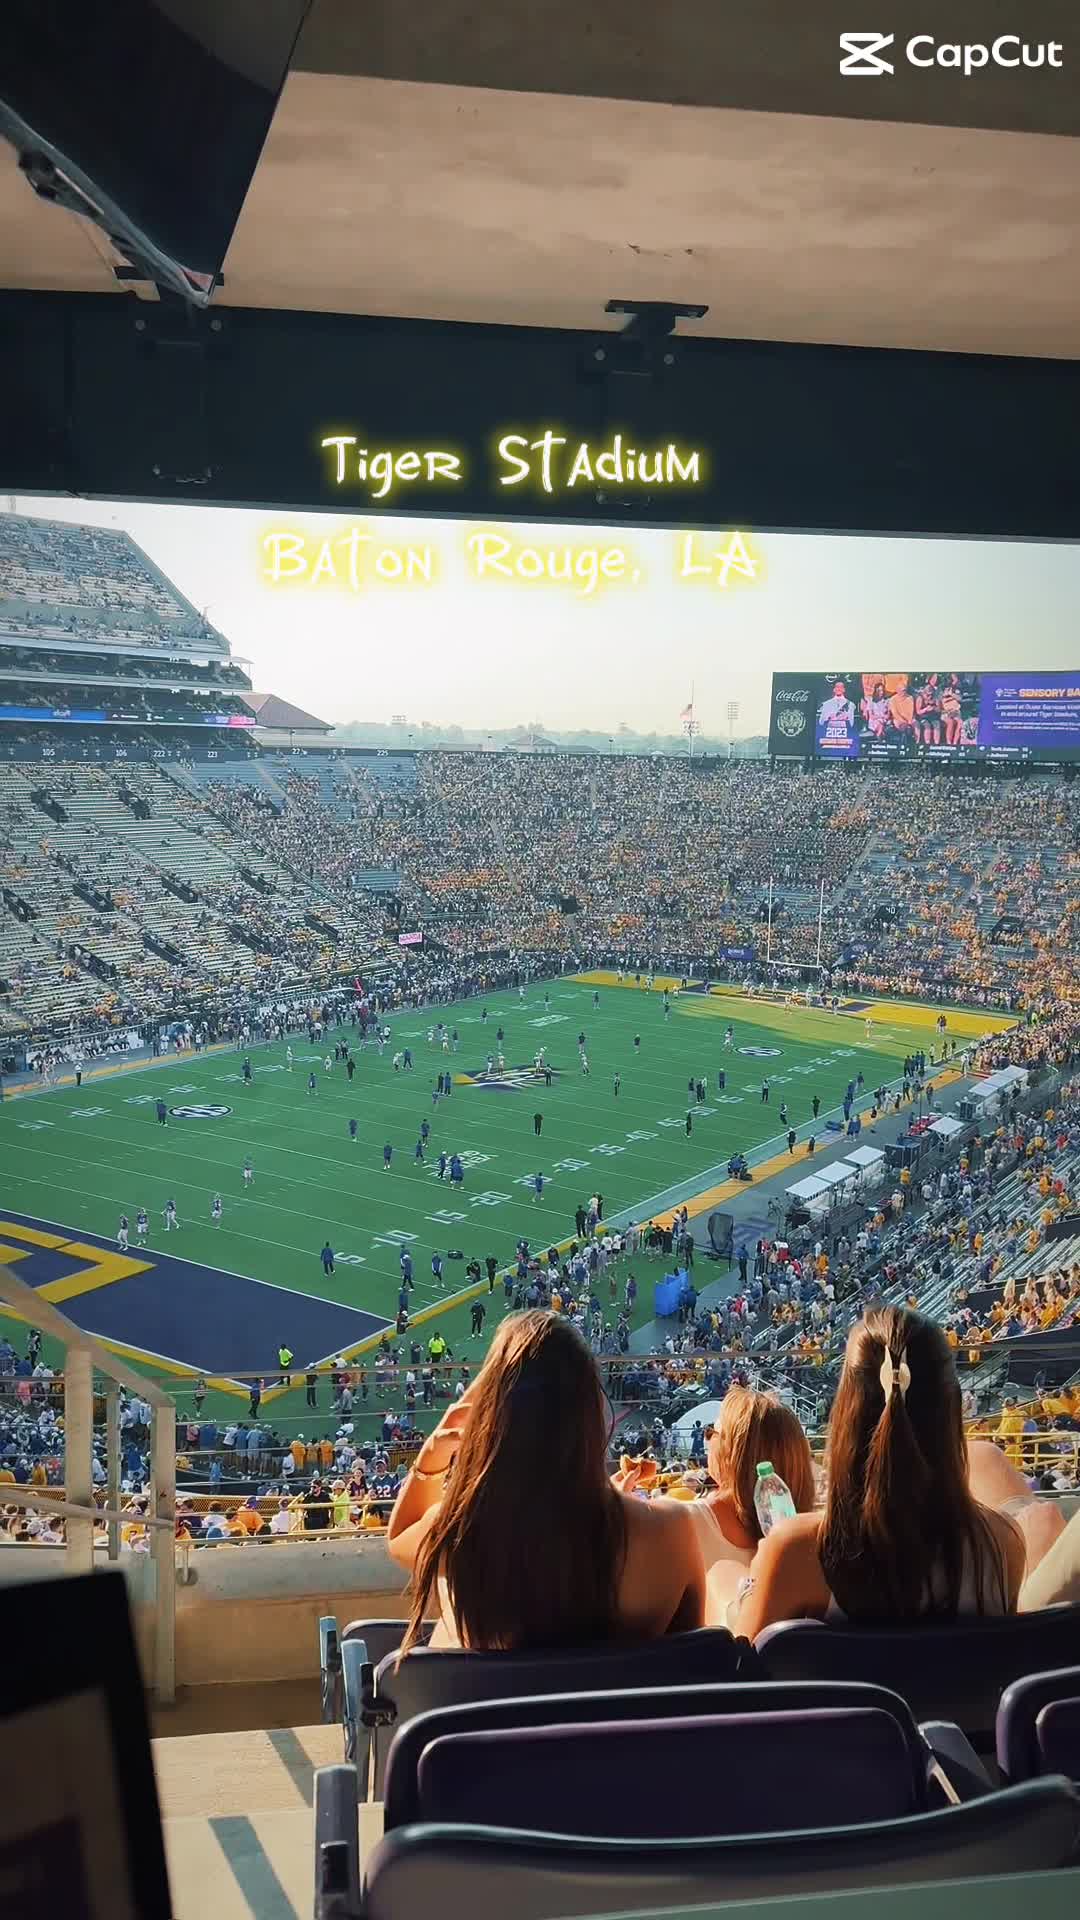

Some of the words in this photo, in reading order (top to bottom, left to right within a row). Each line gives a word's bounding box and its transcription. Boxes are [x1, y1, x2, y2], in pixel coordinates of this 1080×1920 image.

[1019, 688, 1066, 697] SENSORY
[825, 727, 848, 738] 2023
[424, 1209, 469, 1225] 15
[376, 1485, 391, 1498] 22
